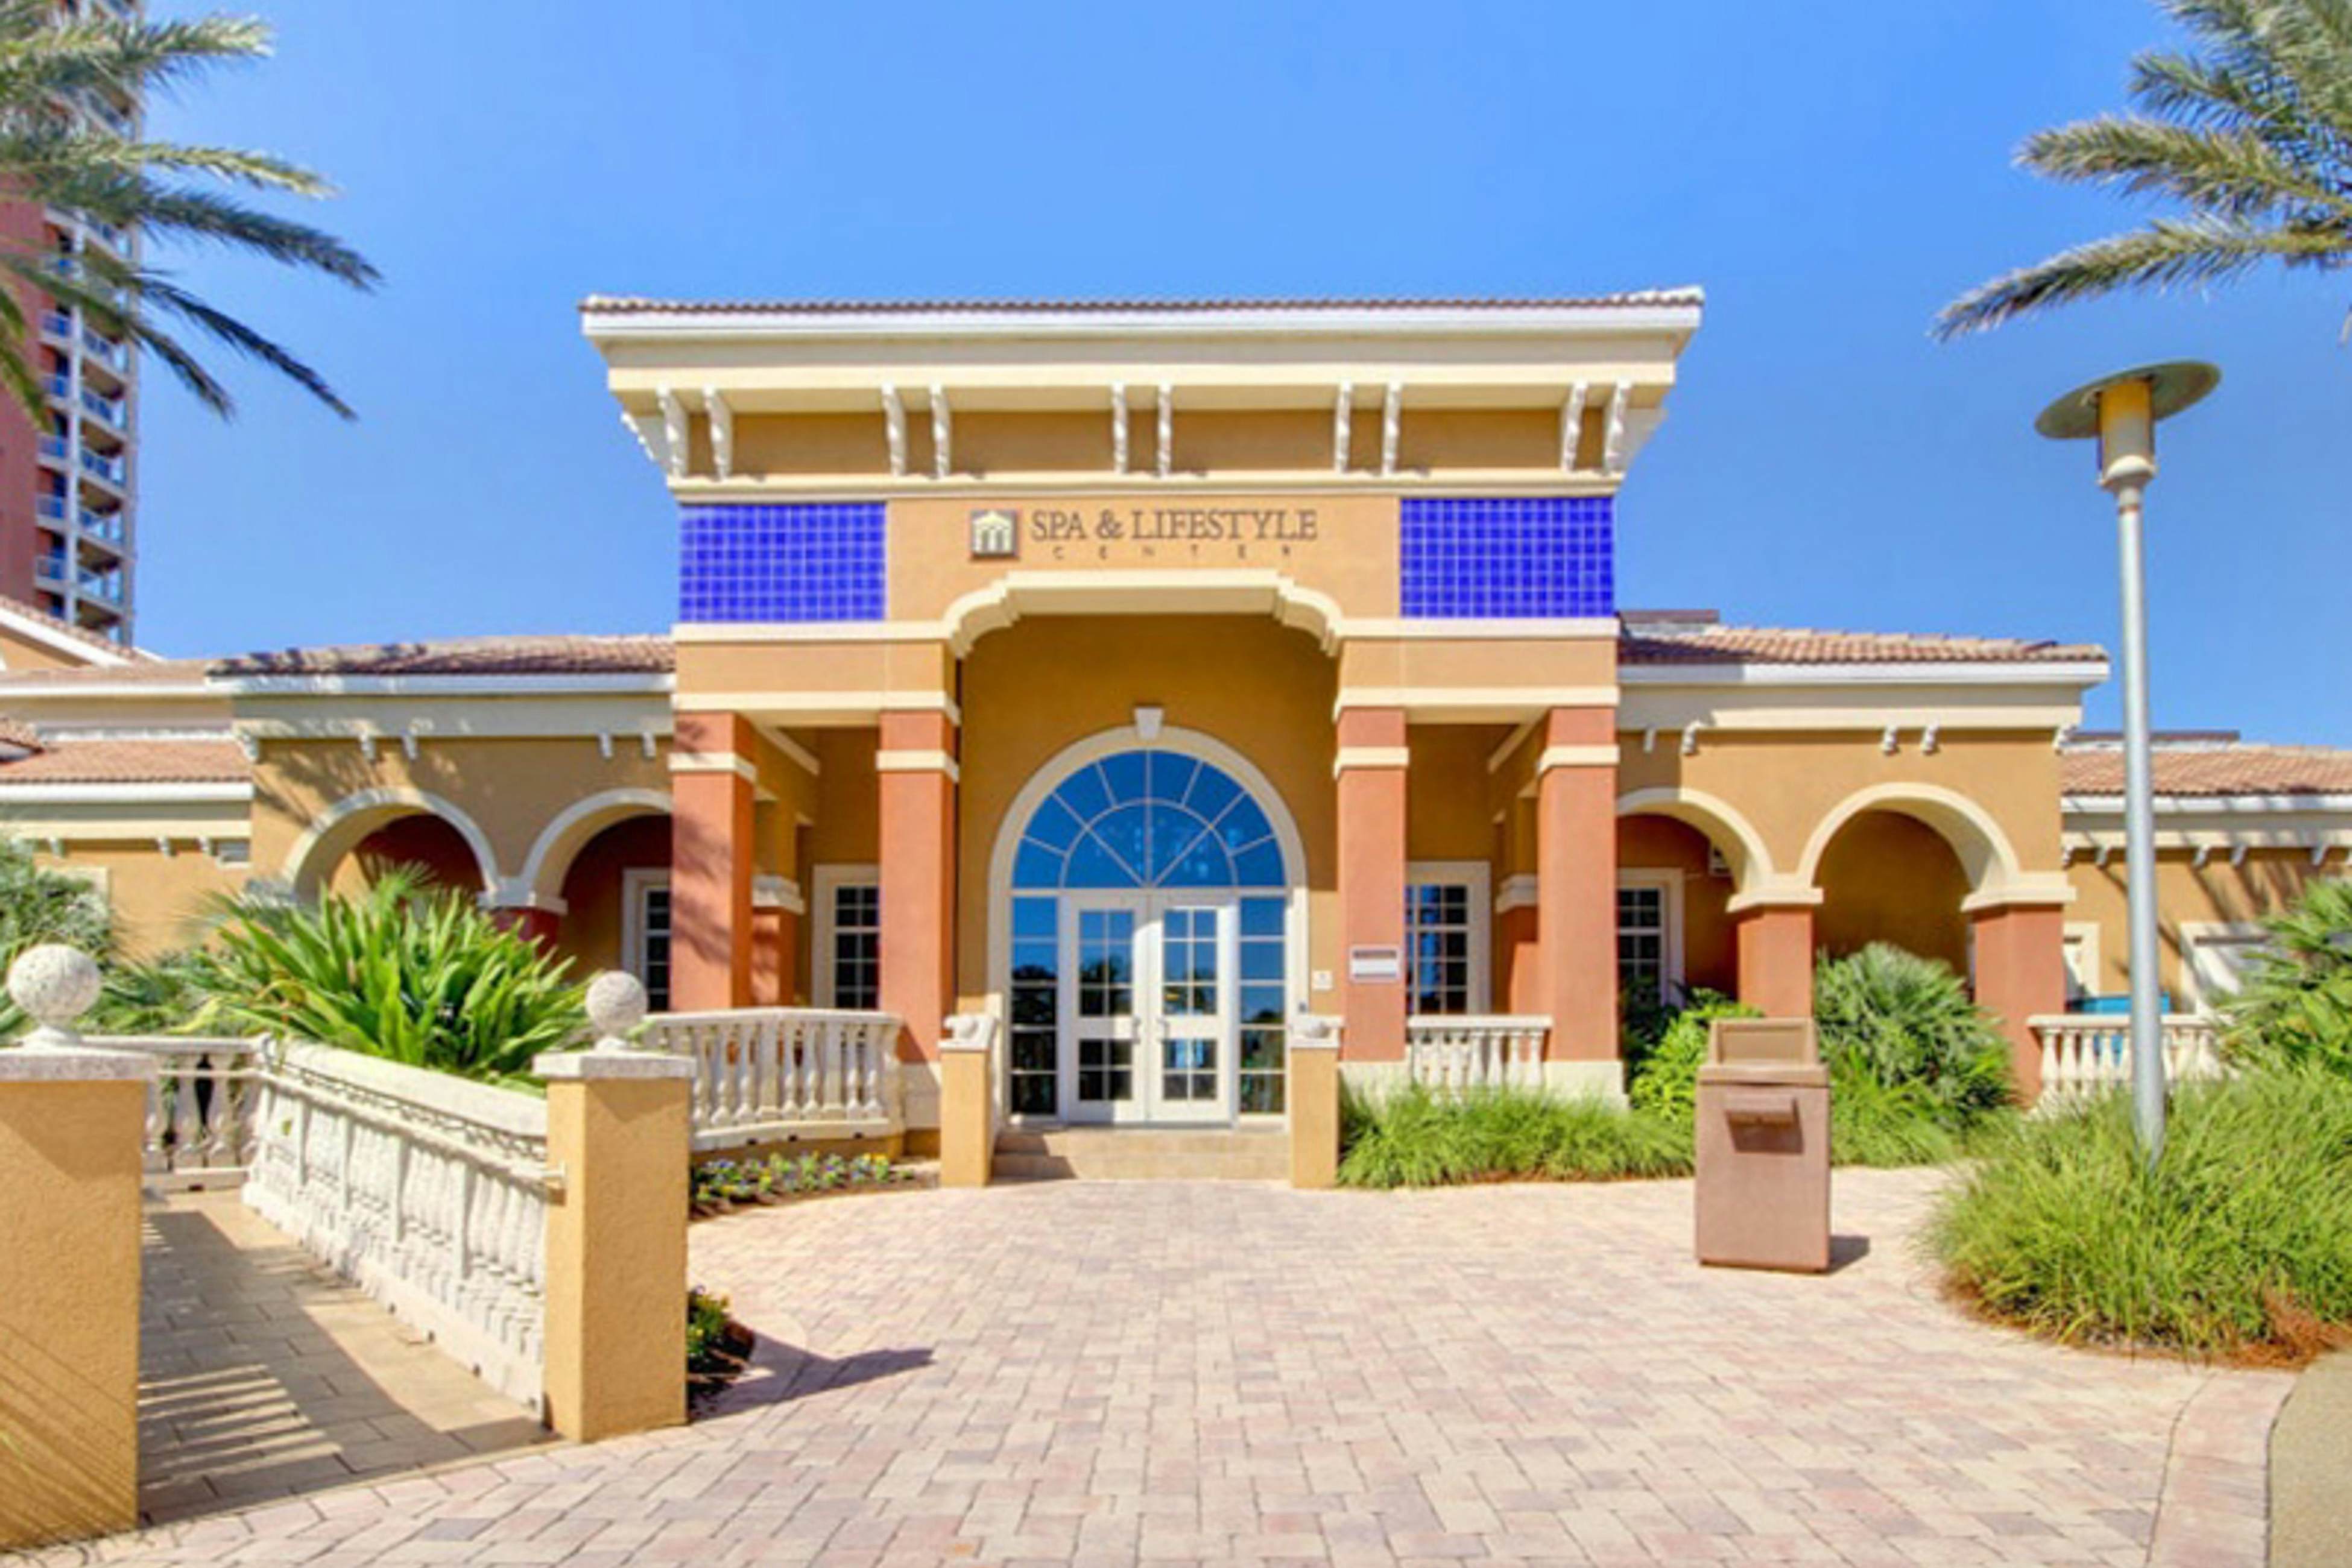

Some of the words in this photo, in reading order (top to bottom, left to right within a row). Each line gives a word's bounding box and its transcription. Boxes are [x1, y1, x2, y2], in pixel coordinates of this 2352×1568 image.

[1031, 510, 1087, 541] SPA
[1095, 509, 1124, 540] &
[1131, 509, 1318, 540] LIFESTYLE
